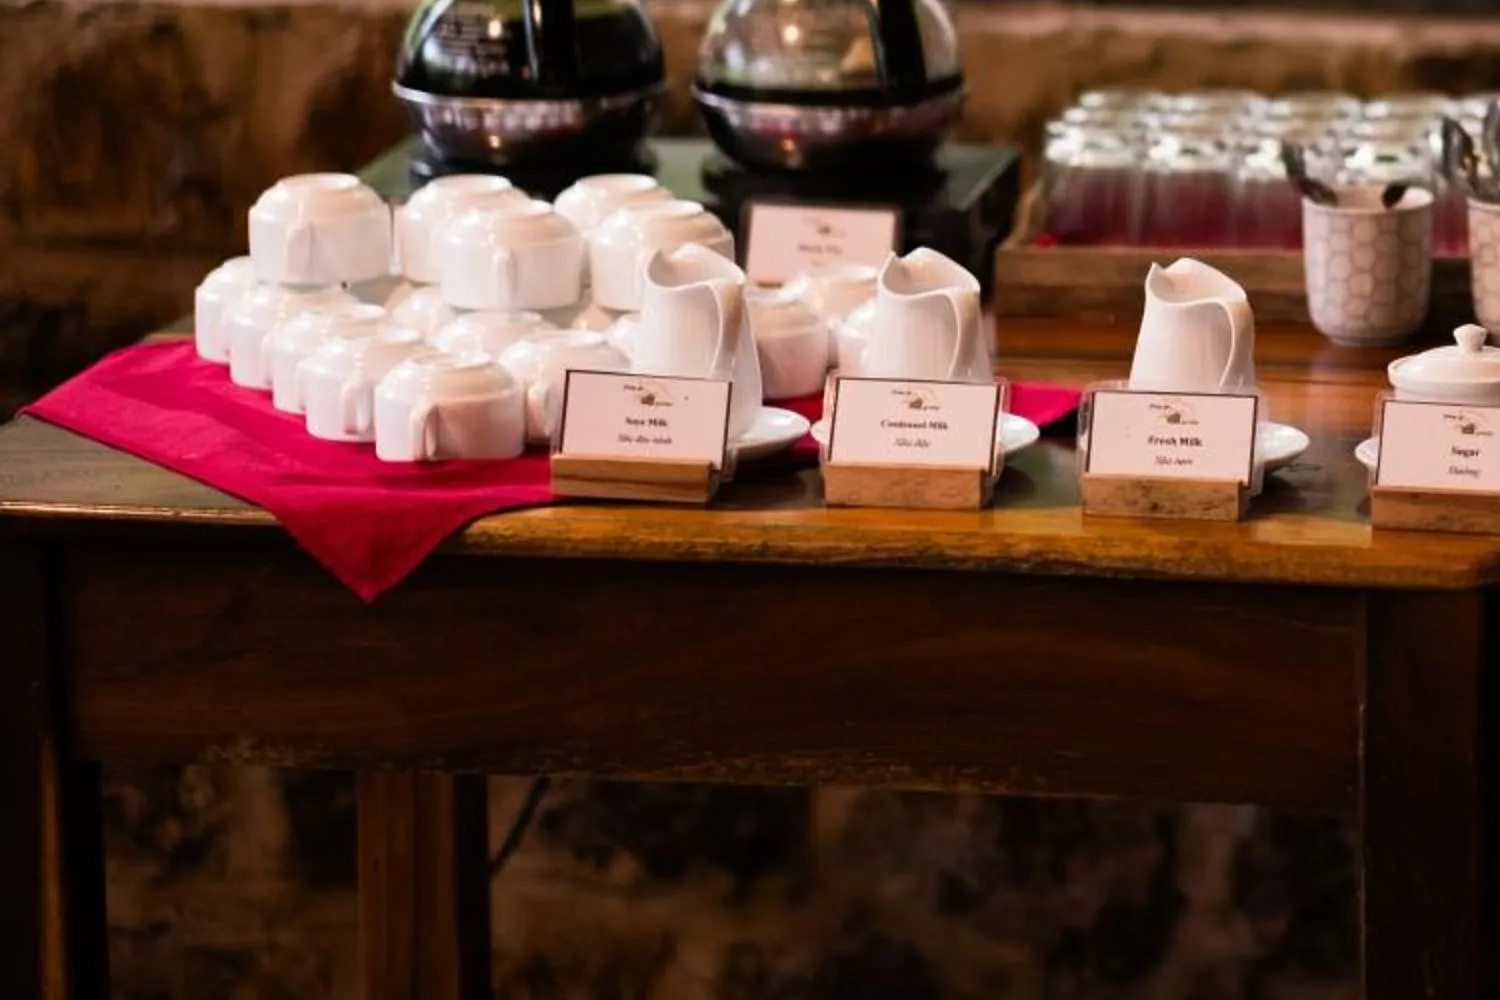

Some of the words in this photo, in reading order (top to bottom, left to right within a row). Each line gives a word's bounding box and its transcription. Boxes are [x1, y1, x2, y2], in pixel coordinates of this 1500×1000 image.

[1148, 434, 1177, 446] Fresh
[1179, 435, 1203, 448] Milk
[1451, 445, 1480, 459] Sugar
